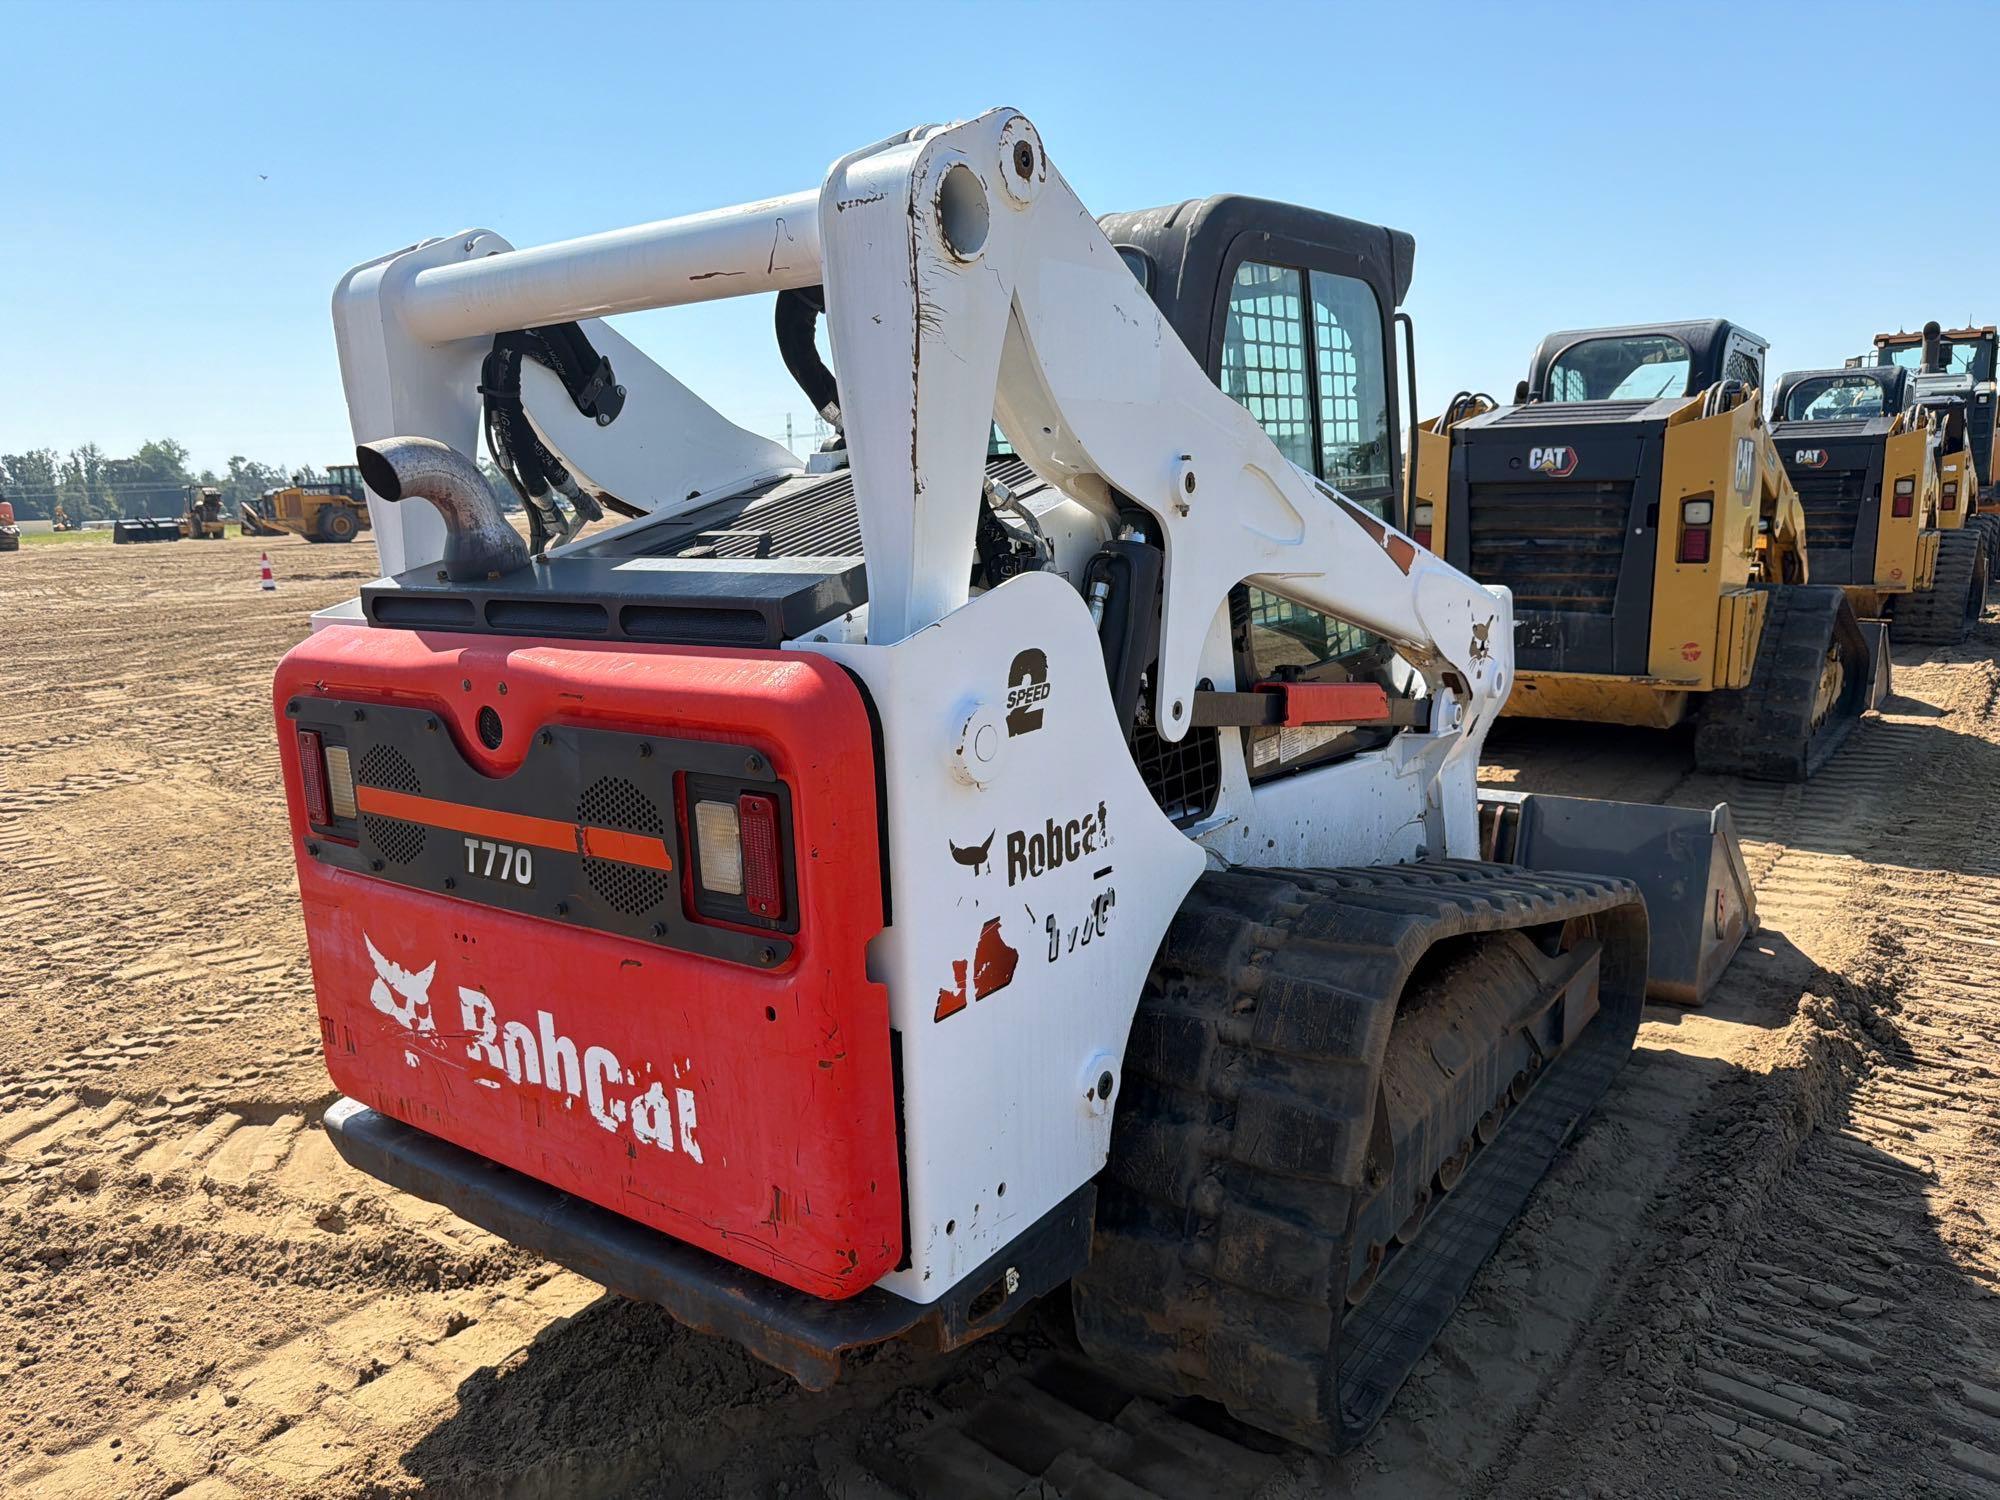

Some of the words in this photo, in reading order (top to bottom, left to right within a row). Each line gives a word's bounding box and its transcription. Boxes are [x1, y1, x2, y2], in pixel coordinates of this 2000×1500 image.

[1529, 447, 1567, 471] CAT
[1735, 438, 1754, 492] CAT
[1795, 449, 1820, 464] CAT
[1006, 683, 1051, 709] SPEED
[464, 837, 532, 885] T770
